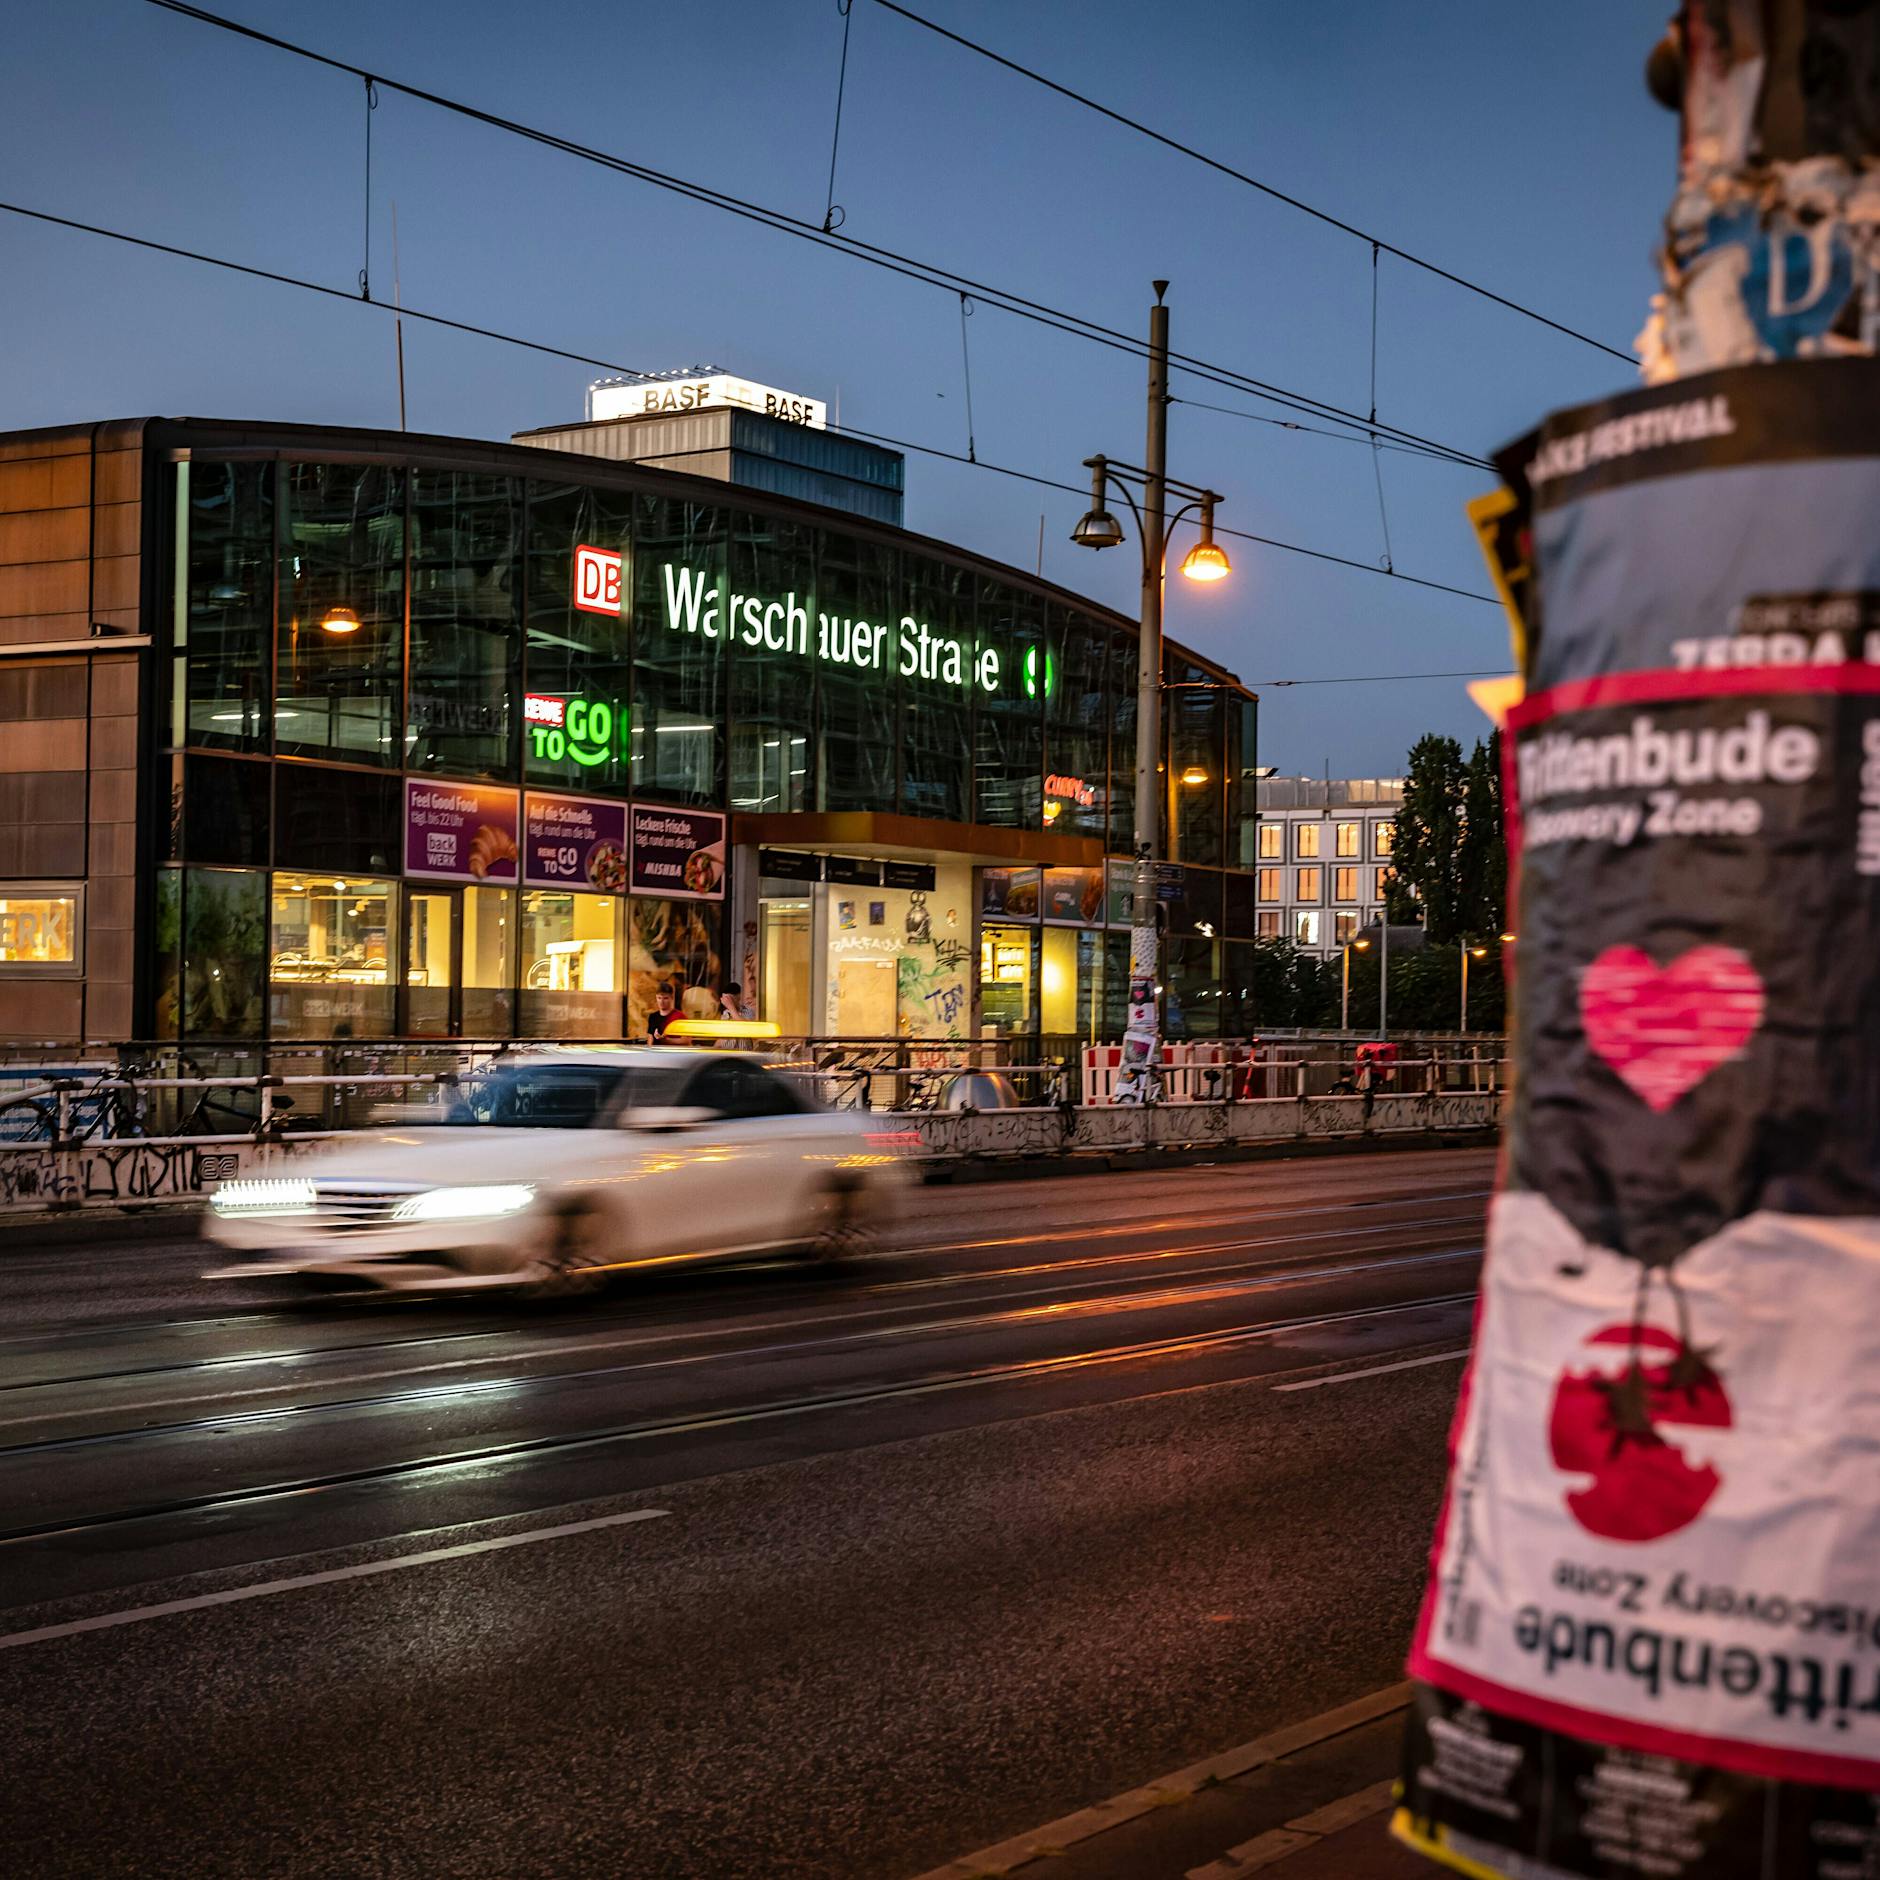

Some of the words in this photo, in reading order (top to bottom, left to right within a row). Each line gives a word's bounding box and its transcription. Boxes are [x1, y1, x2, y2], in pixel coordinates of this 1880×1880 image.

[645, 383, 710, 413] BASF
[766, 393, 813, 427] BASF
[583, 557, 622, 604] DB
[900, 616, 1000, 692] Strae
[532, 727, 565, 761] TO
[566, 700, 612, 745] GO
[411, 791, 431, 808] Feel
[431, 794, 456, 811] Good
[456, 796, 478, 813] Food
[558, 807, 593, 825] Schnelle
[1645, 790, 1764, 836] Zone
[428, 812, 439, 825] bis
[451, 814, 464, 827] Uhr
[635, 815, 665, 833] Leckere
[665, 819, 691, 835] Frische
[429, 834, 455, 851] back
[427, 853, 457, 868] WERK
[544, 860, 558, 874] TO
[558, 847, 578, 866] GO
[1554, 1559, 1650, 1613] Zone
